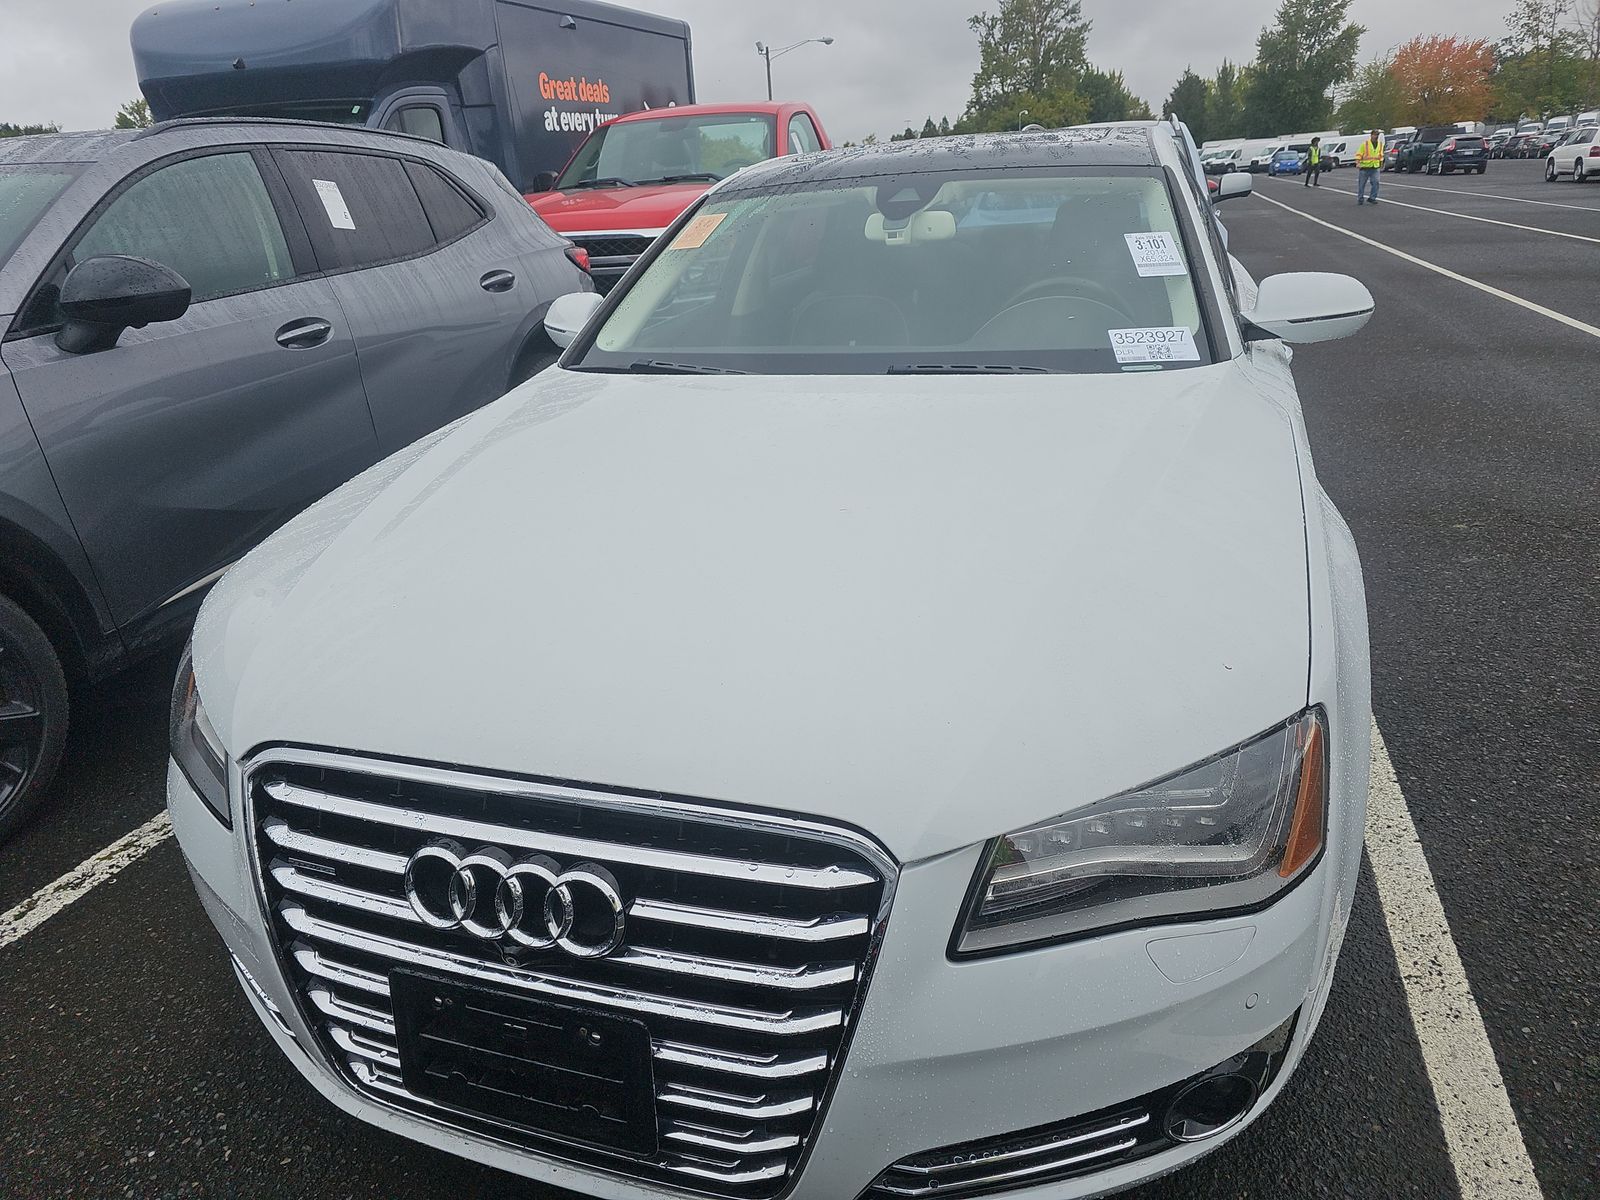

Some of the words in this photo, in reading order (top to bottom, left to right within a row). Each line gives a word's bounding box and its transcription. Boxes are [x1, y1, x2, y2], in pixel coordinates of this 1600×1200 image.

[539, 72, 578, 100] Great
[579, 77, 610, 103] deals
[544, 106, 560, 131] at
[561, 111, 594, 135] every
[595, 108, 618, 126] tu
[1135, 239, 1167, 250] 3:101
[1114, 331, 1184, 344] 3523927
